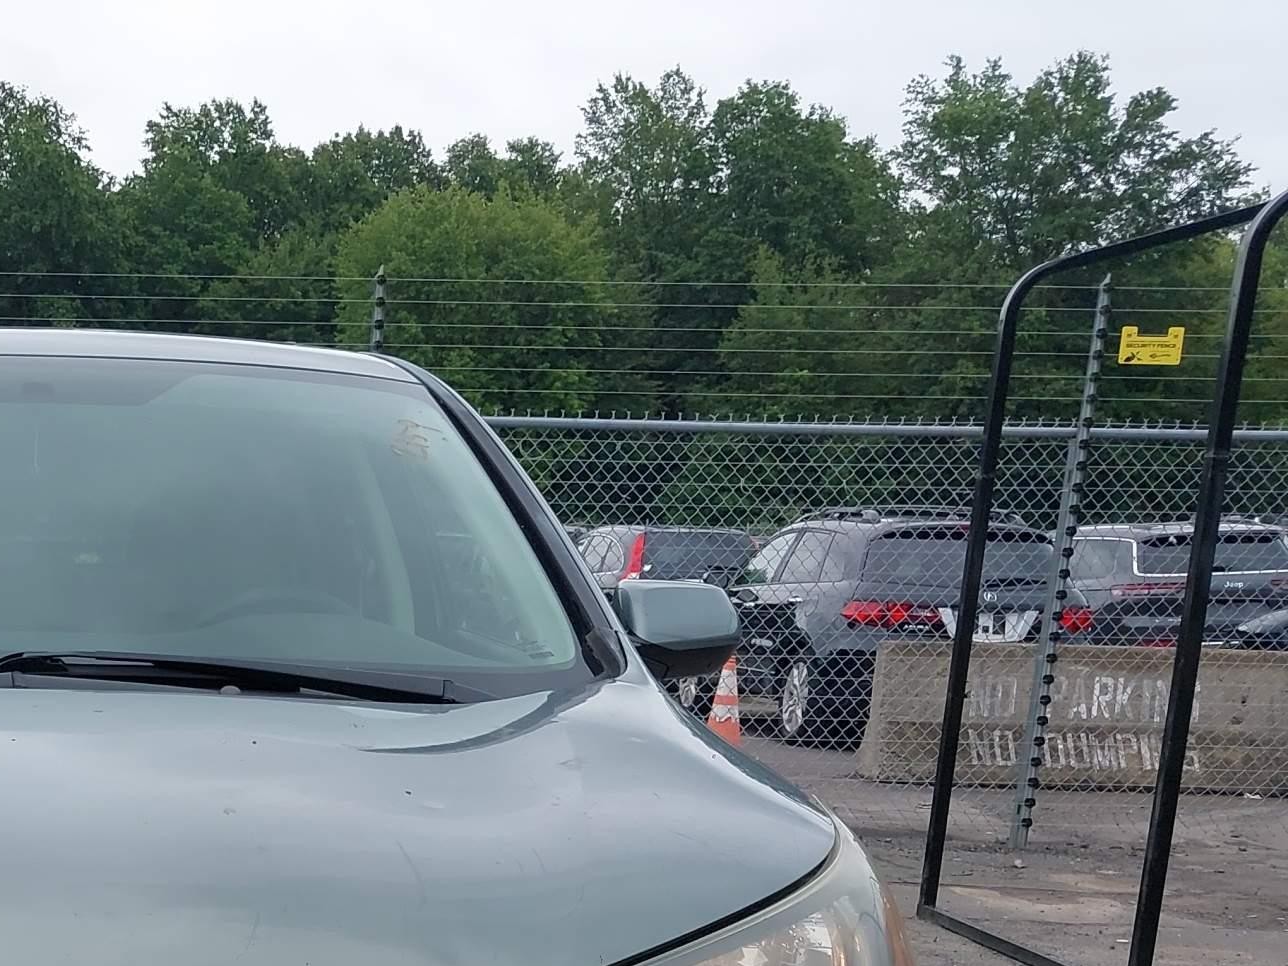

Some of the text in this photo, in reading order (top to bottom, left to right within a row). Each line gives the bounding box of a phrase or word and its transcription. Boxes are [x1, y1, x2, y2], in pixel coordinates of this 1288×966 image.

[1223, 581, 1244, 589] Jeep
[968, 676, 1018, 718] NO
[967, 729, 1018, 766] NO
